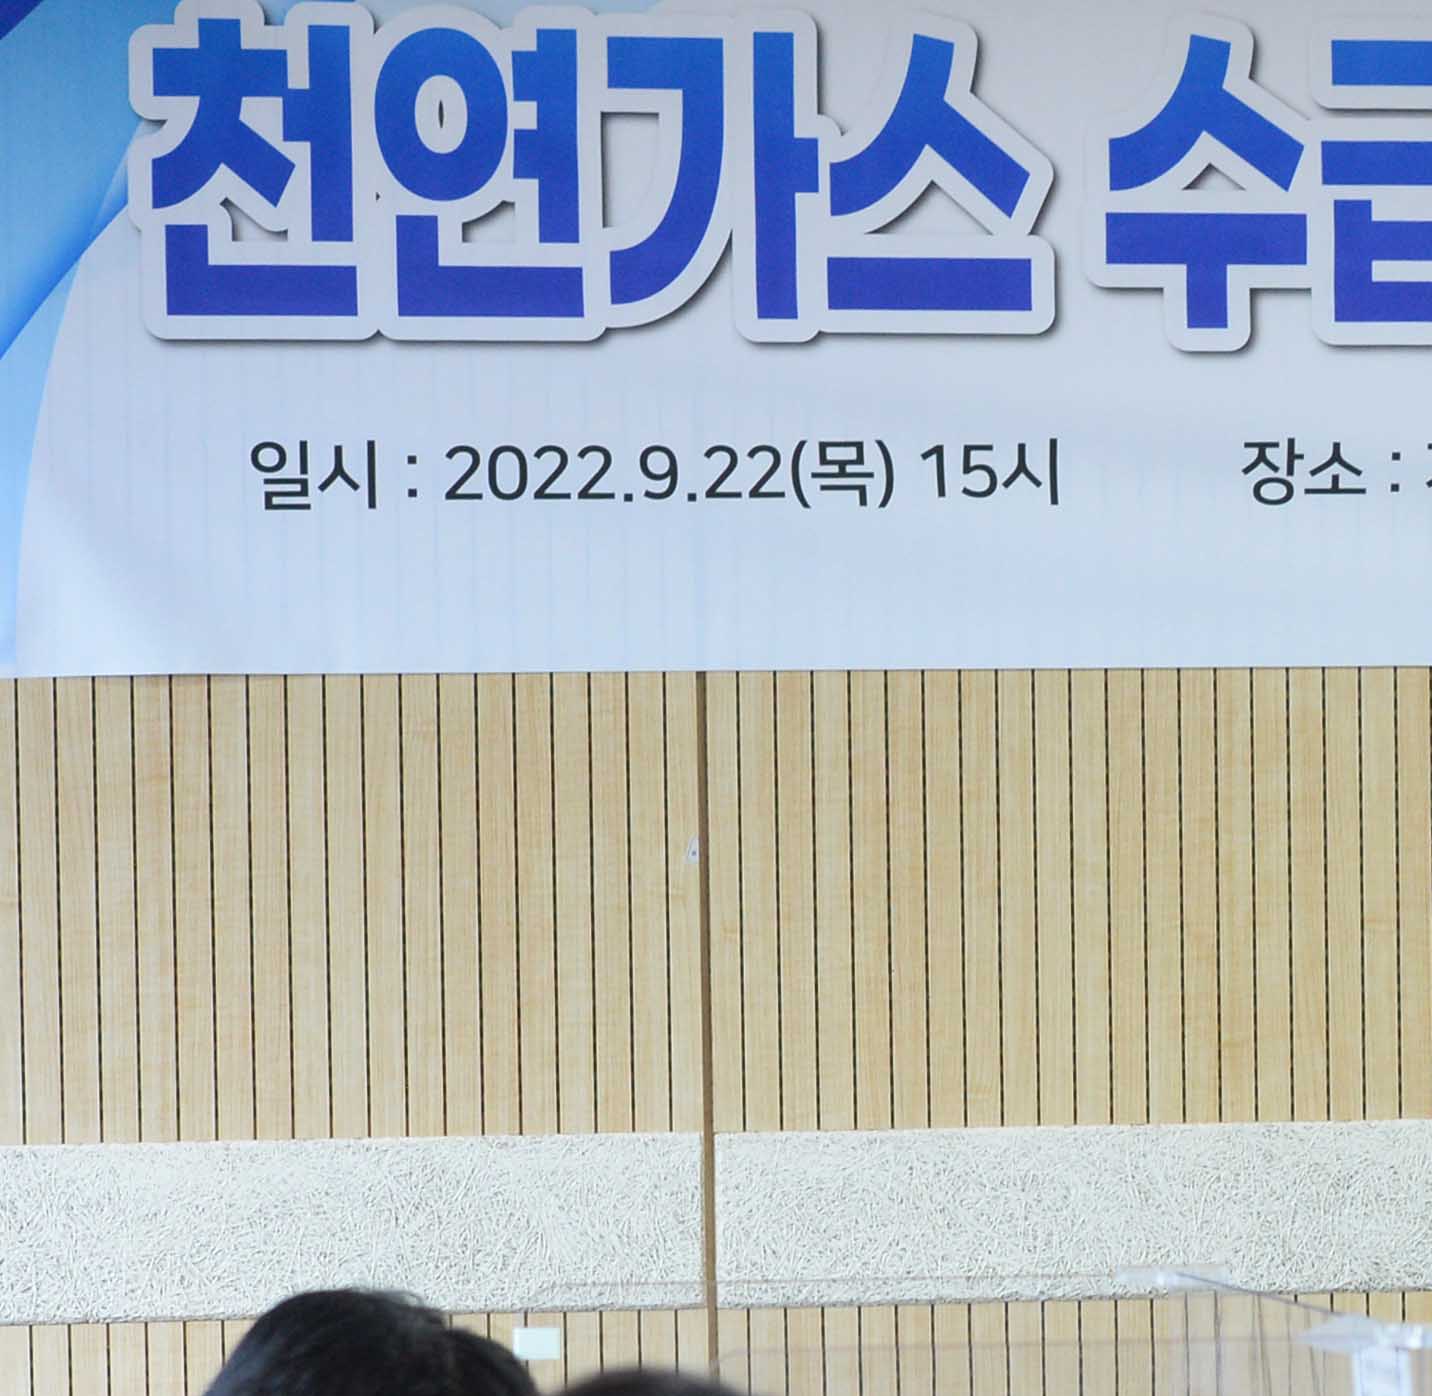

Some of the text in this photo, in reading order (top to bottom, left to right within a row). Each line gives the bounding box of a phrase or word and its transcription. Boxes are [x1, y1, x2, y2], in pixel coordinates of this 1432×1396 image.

[152, 19, 1031, 320] 천연가스
[250, 440, 377, 510] 일시
[446, 440, 894, 509] 2022.9.22(목)
[920, 439, 1060, 505] 15시
[1241, 437, 1367, 506] 장소
